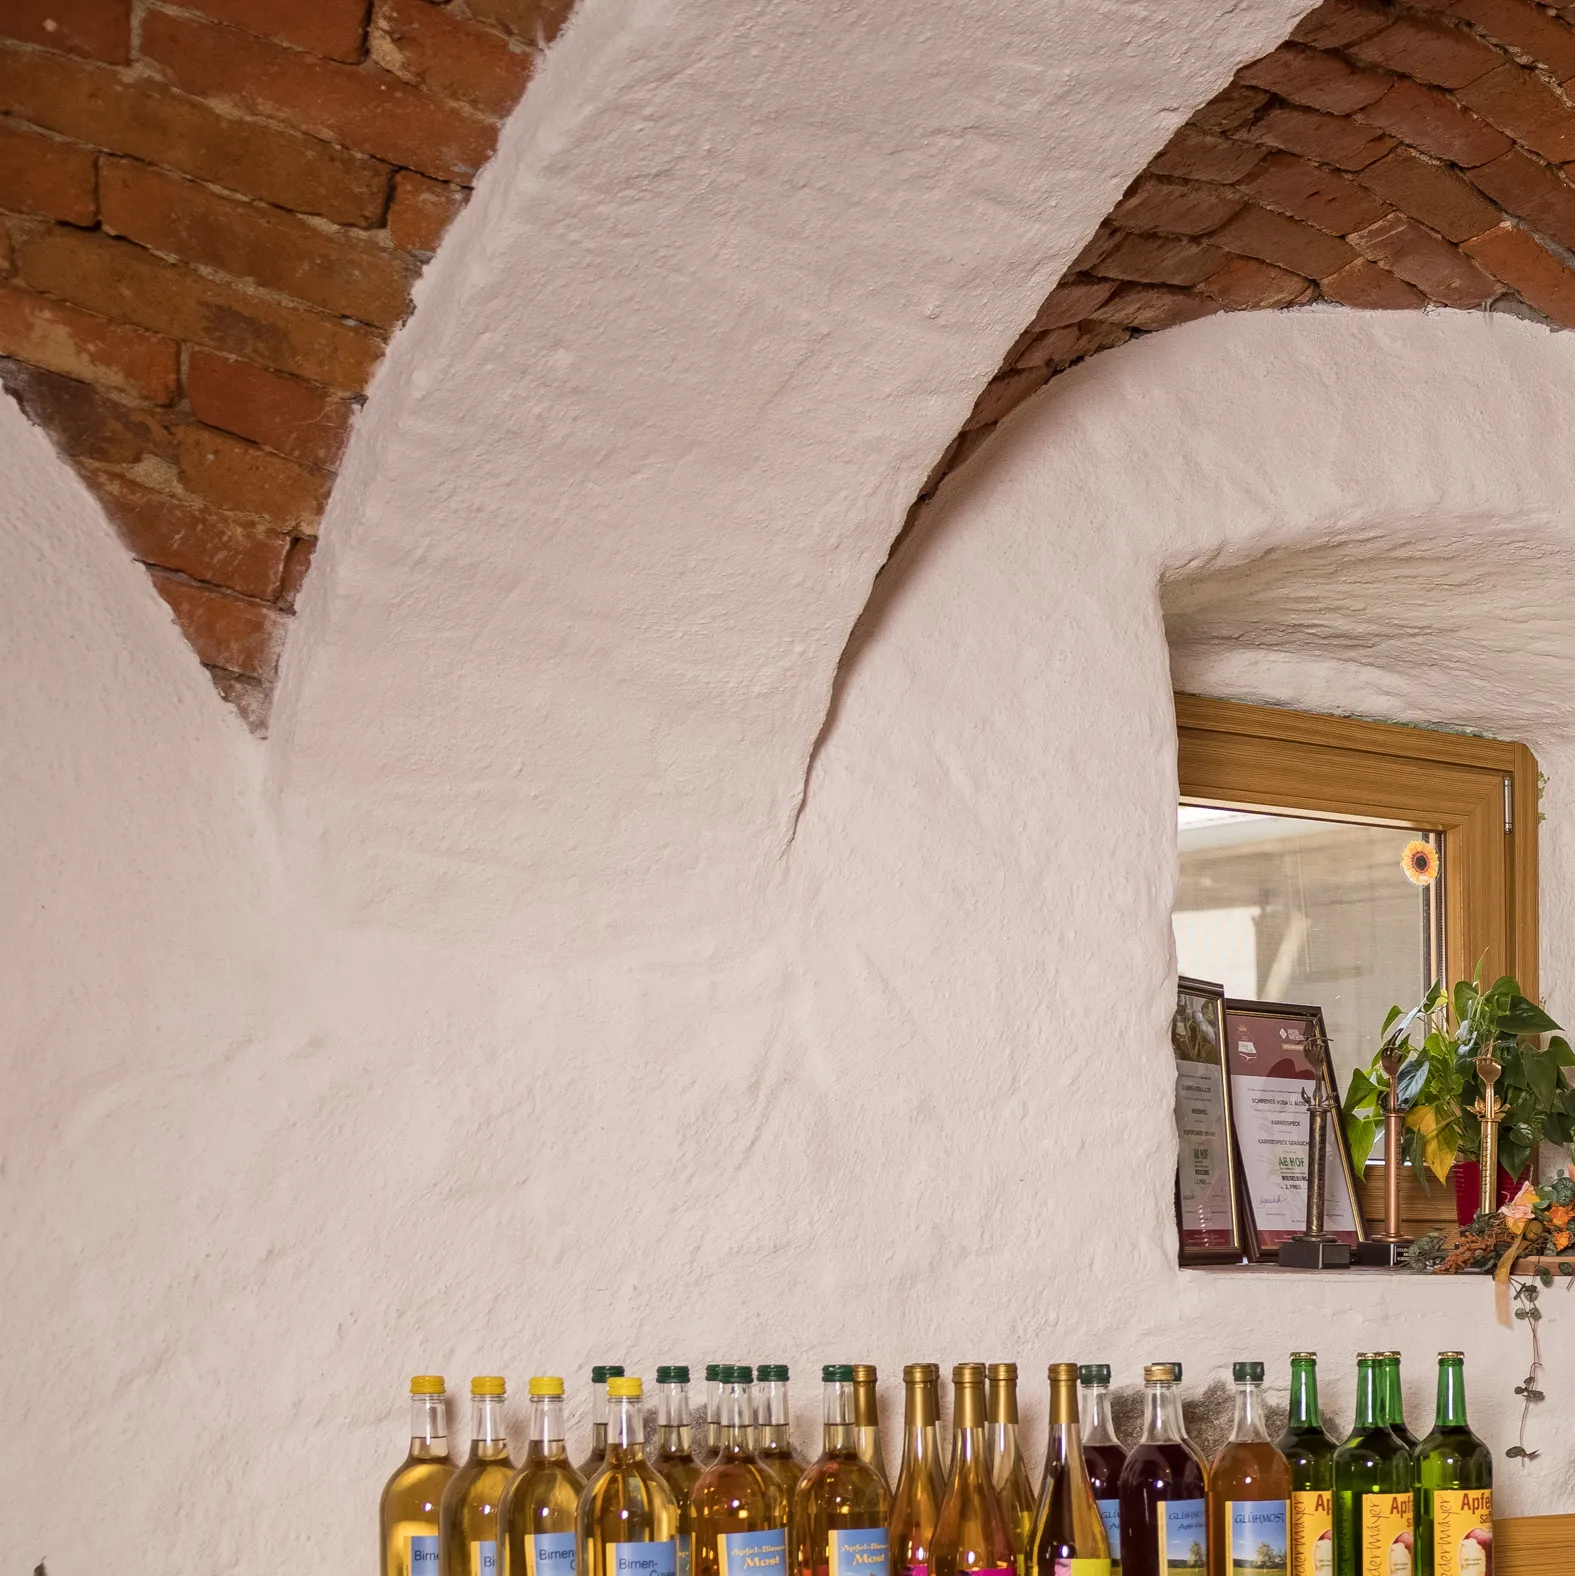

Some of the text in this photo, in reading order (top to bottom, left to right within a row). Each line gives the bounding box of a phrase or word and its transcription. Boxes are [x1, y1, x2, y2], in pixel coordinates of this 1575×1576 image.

[1234, 1511, 1286, 1525] GLÜHMOST
[618, 1557, 659, 1572] Birnen-
[742, 1554, 781, 1571] Most
